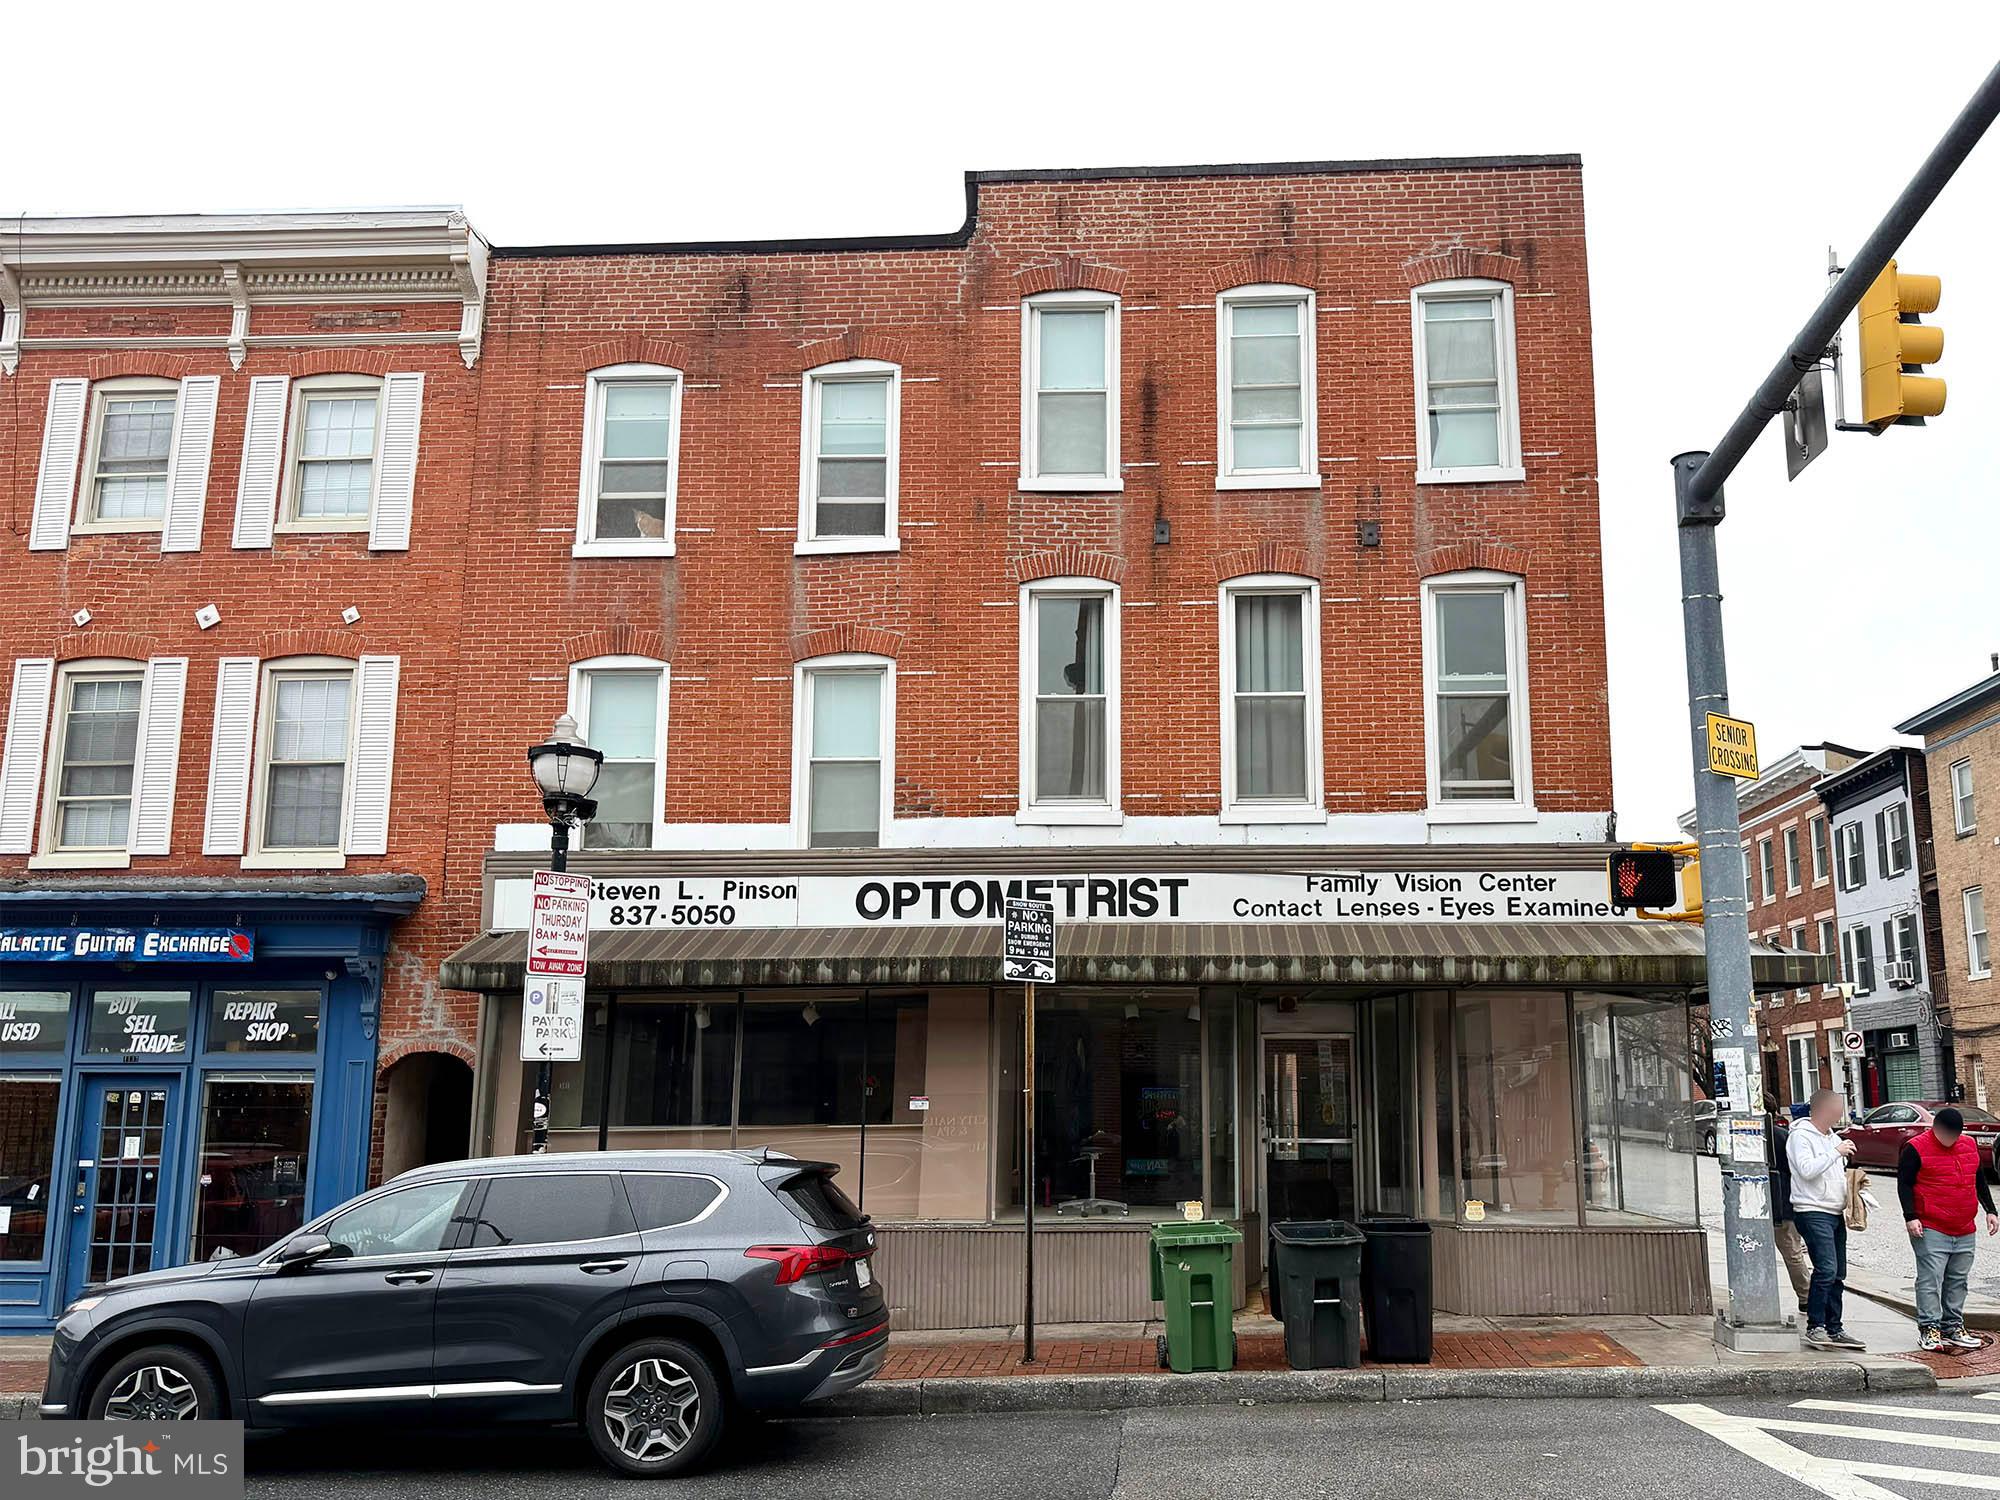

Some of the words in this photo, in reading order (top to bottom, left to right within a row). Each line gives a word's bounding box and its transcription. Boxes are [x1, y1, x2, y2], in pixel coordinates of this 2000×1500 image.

[1715, 722, 1748, 747] SENIOR
[1711, 746, 1756, 773] CROSSING
[536, 873, 548, 885] NO
[549, 875, 588, 889] STOPPING
[678, 880, 704, 900] L.
[723, 880, 798, 900] Pinson
[1306, 874, 1379, 896] Family
[1395, 873, 1462, 893] Vision
[1479, 873, 1557, 892] Center
[536, 897, 550, 910] NO
[551, 899, 586, 913] PARKING
[1233, 898, 1323, 917] Contact
[1337, 898, 1420, 917] Lenses
[1440, 897, 1495, 920] Eyes
[541, 913, 583, 928] THURSDAY
[1022, 910, 1039, 922] NO
[1007, 920, 1052, 934] PARKING
[532, 960, 547, 970] TOW
[547, 961, 566, 972] AWAY
[566, 962, 583, 973] ZONE
[108, 998, 141, 1015] BUY
[223, 1002, 278, 1021] REPAIR
[123, 1014, 157, 1034] SELL
[532, 1016, 554, 1026] PAY
[1, 1022, 41, 1042] USED
[245, 1022, 290, 1041] SHOP
[535, 1028, 568, 1039] PARK
[128, 1034, 179, 1054] TRADE
